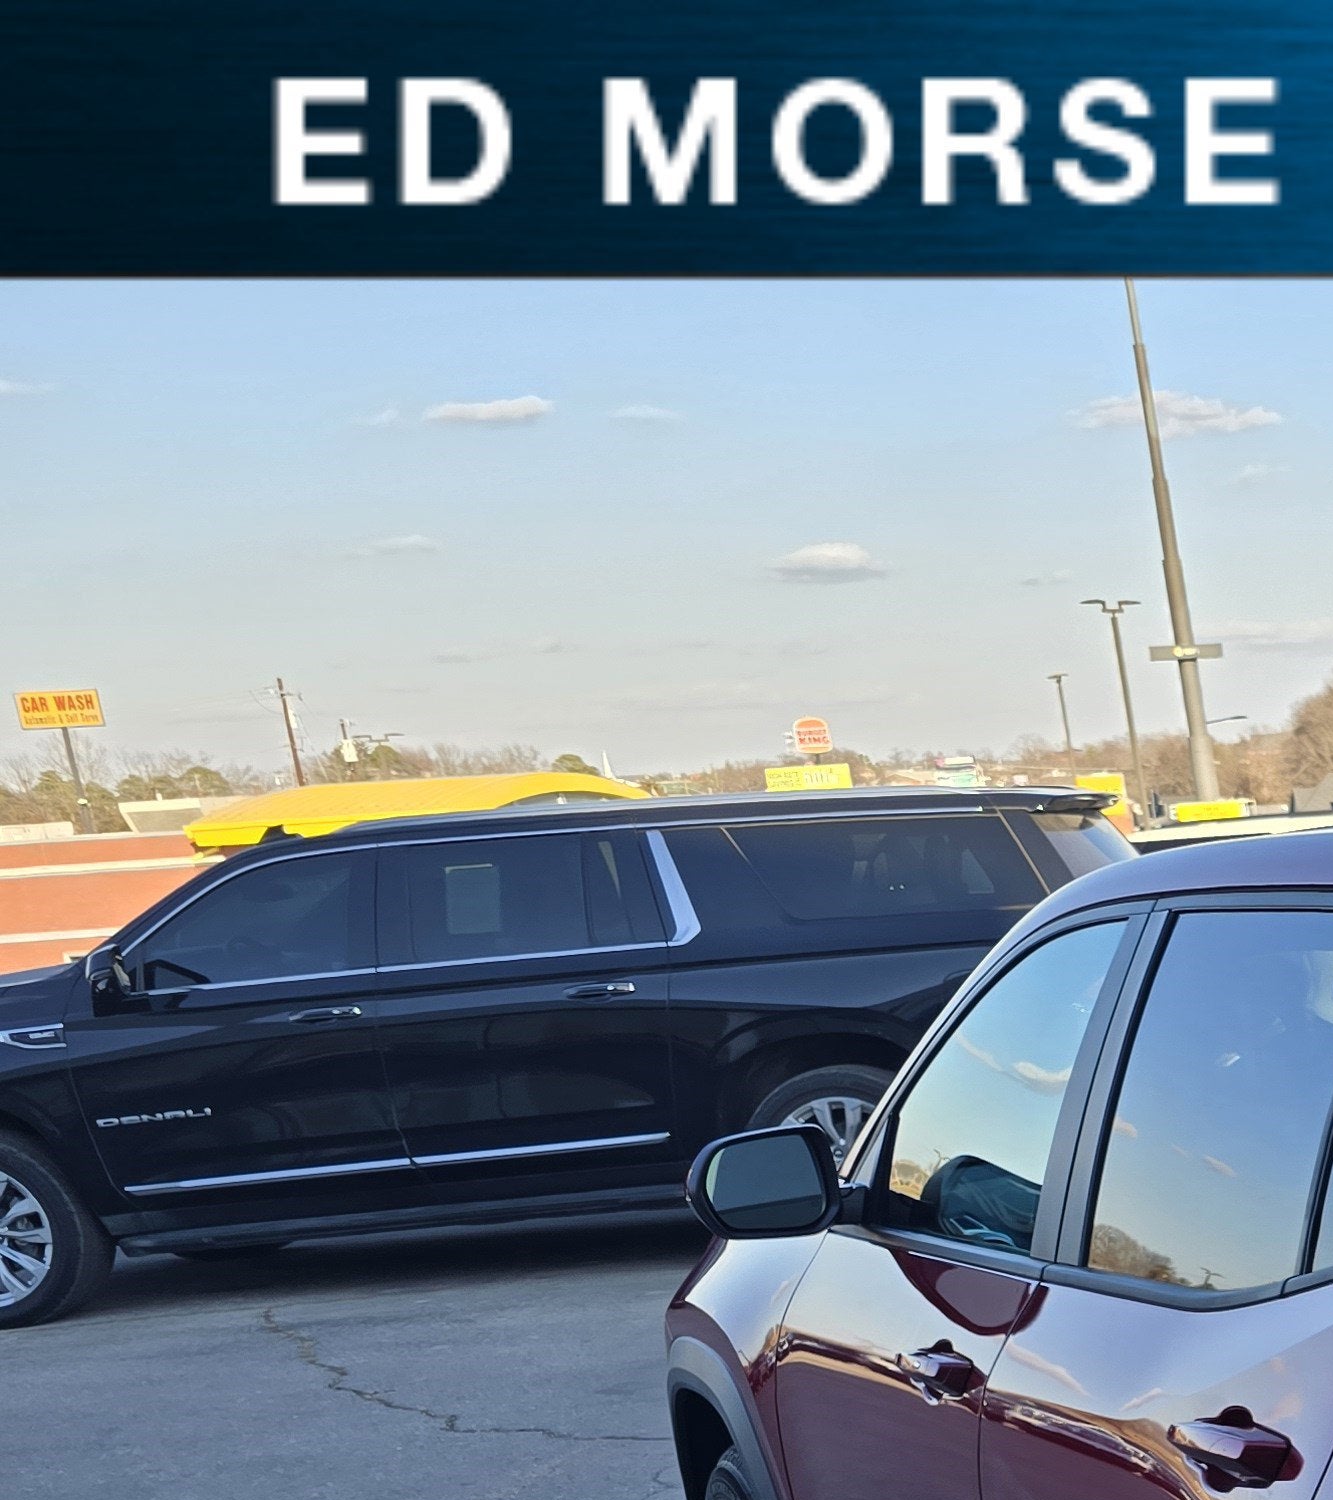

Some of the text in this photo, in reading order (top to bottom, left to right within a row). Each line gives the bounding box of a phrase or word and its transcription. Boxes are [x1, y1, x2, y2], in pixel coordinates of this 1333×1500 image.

[20, 694, 95, 713] CAR WASH
[798, 736, 830, 744] KING
[96, 1107, 211, 1128] DENALI
